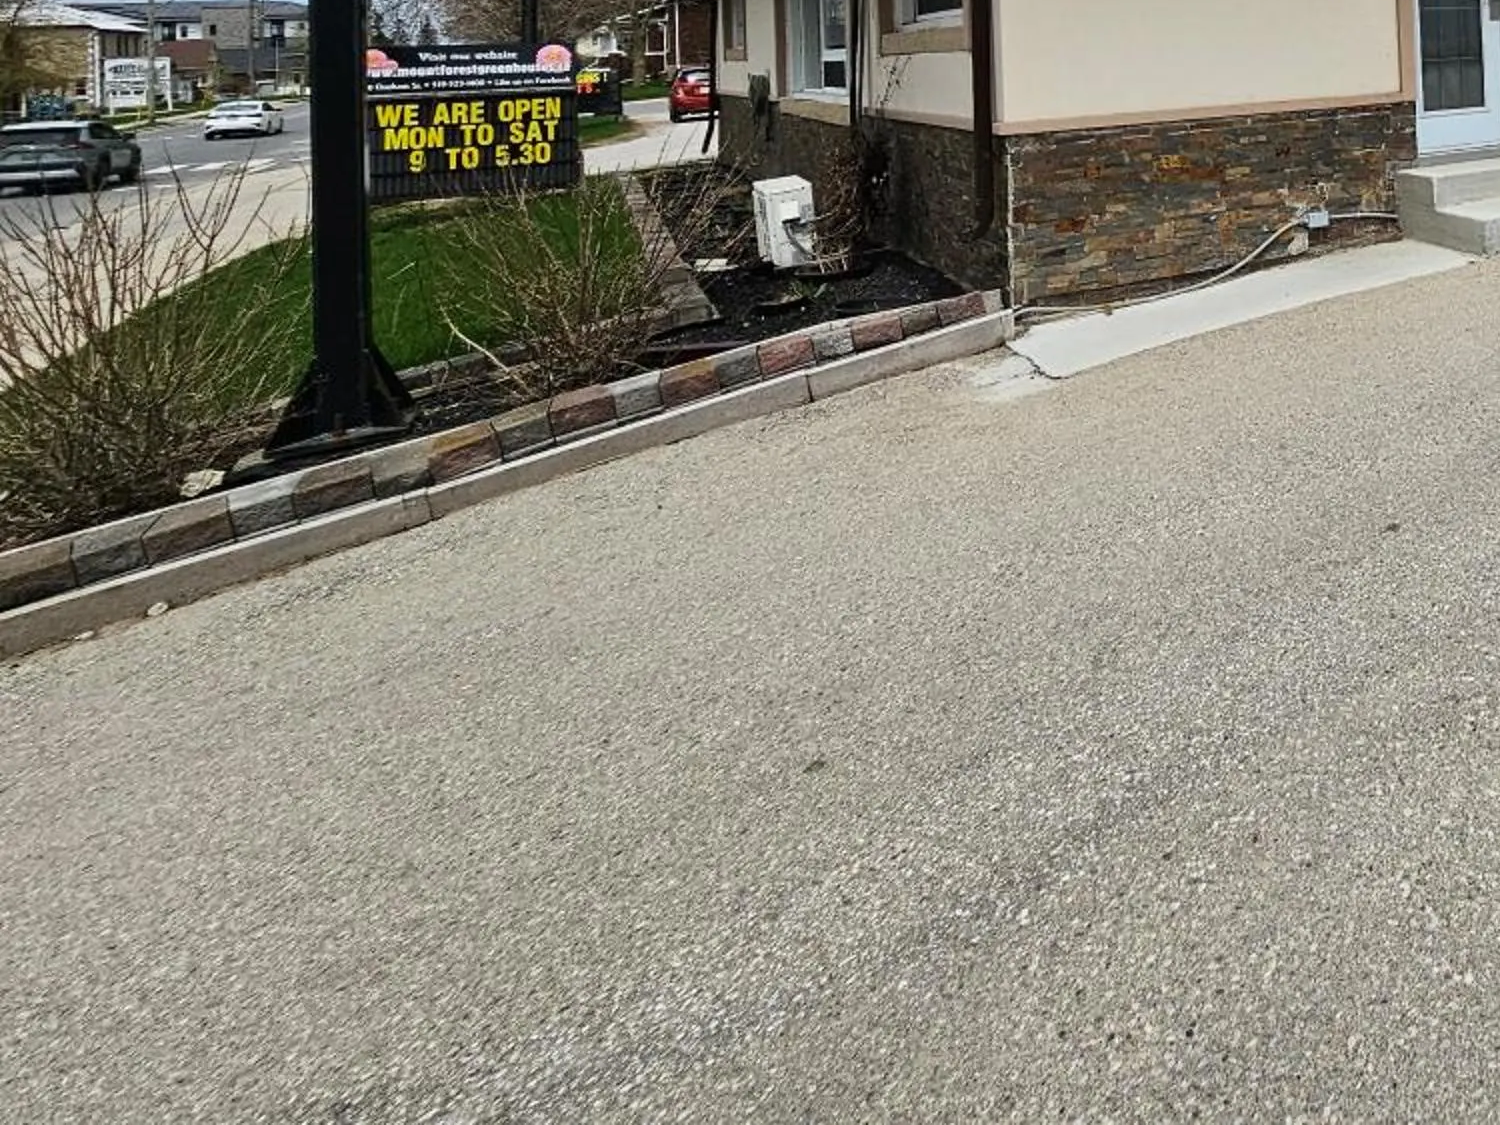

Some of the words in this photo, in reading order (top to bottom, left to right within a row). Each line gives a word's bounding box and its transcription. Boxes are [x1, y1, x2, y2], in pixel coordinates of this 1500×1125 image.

[376, 104, 419, 127] WE
[433, 101, 485, 125] ARE
[498, 97, 561, 122] OPEN
[383, 127, 444, 151] MON
[460, 124, 494, 146] TO
[509, 120, 559, 143] SAT
[445, 147, 479, 170] TO
[495, 142, 551, 166] 5.30
